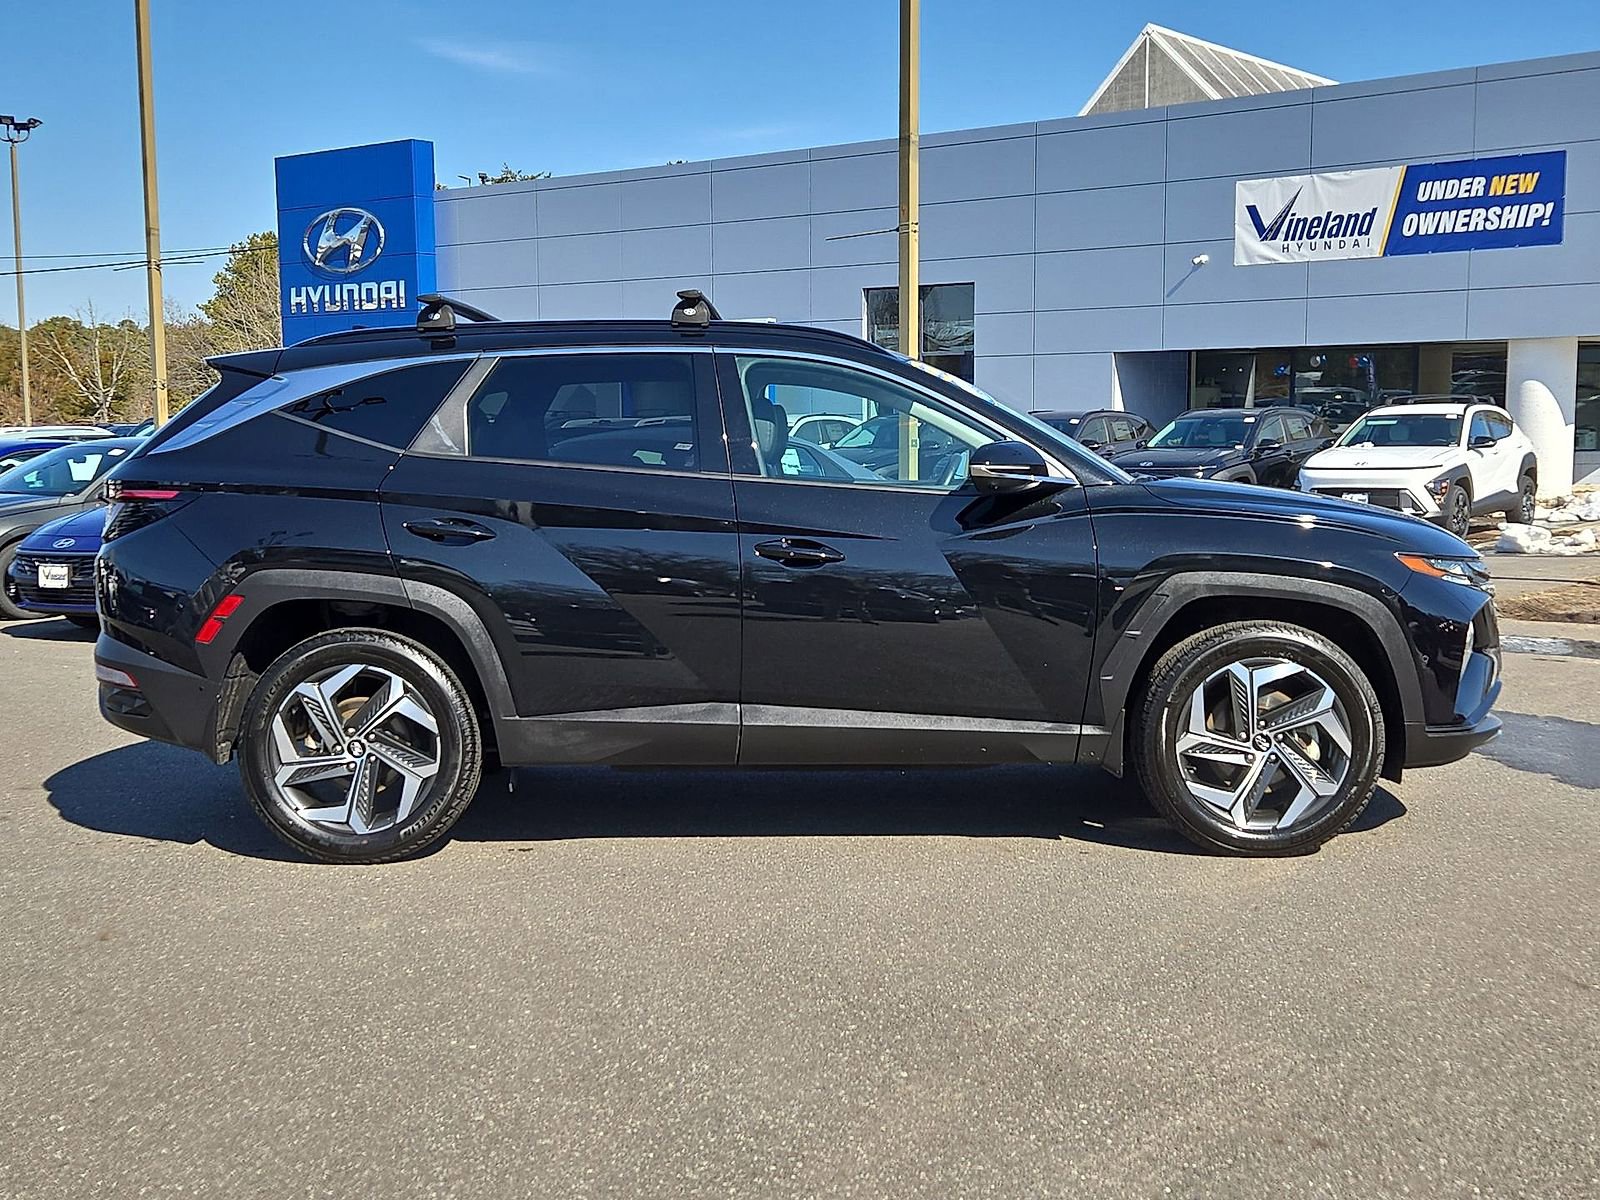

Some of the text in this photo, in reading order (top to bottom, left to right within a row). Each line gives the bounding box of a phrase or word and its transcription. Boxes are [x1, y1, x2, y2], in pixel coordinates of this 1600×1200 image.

[1416, 172, 1540, 202] UNDER NEW
[1246, 185, 1379, 242] Vineland
[1401, 202, 1555, 237] OWNERSHIP!
[1281, 238, 1372, 253] HYUNDAI
[290, 280, 406, 313] HYUNDAI
